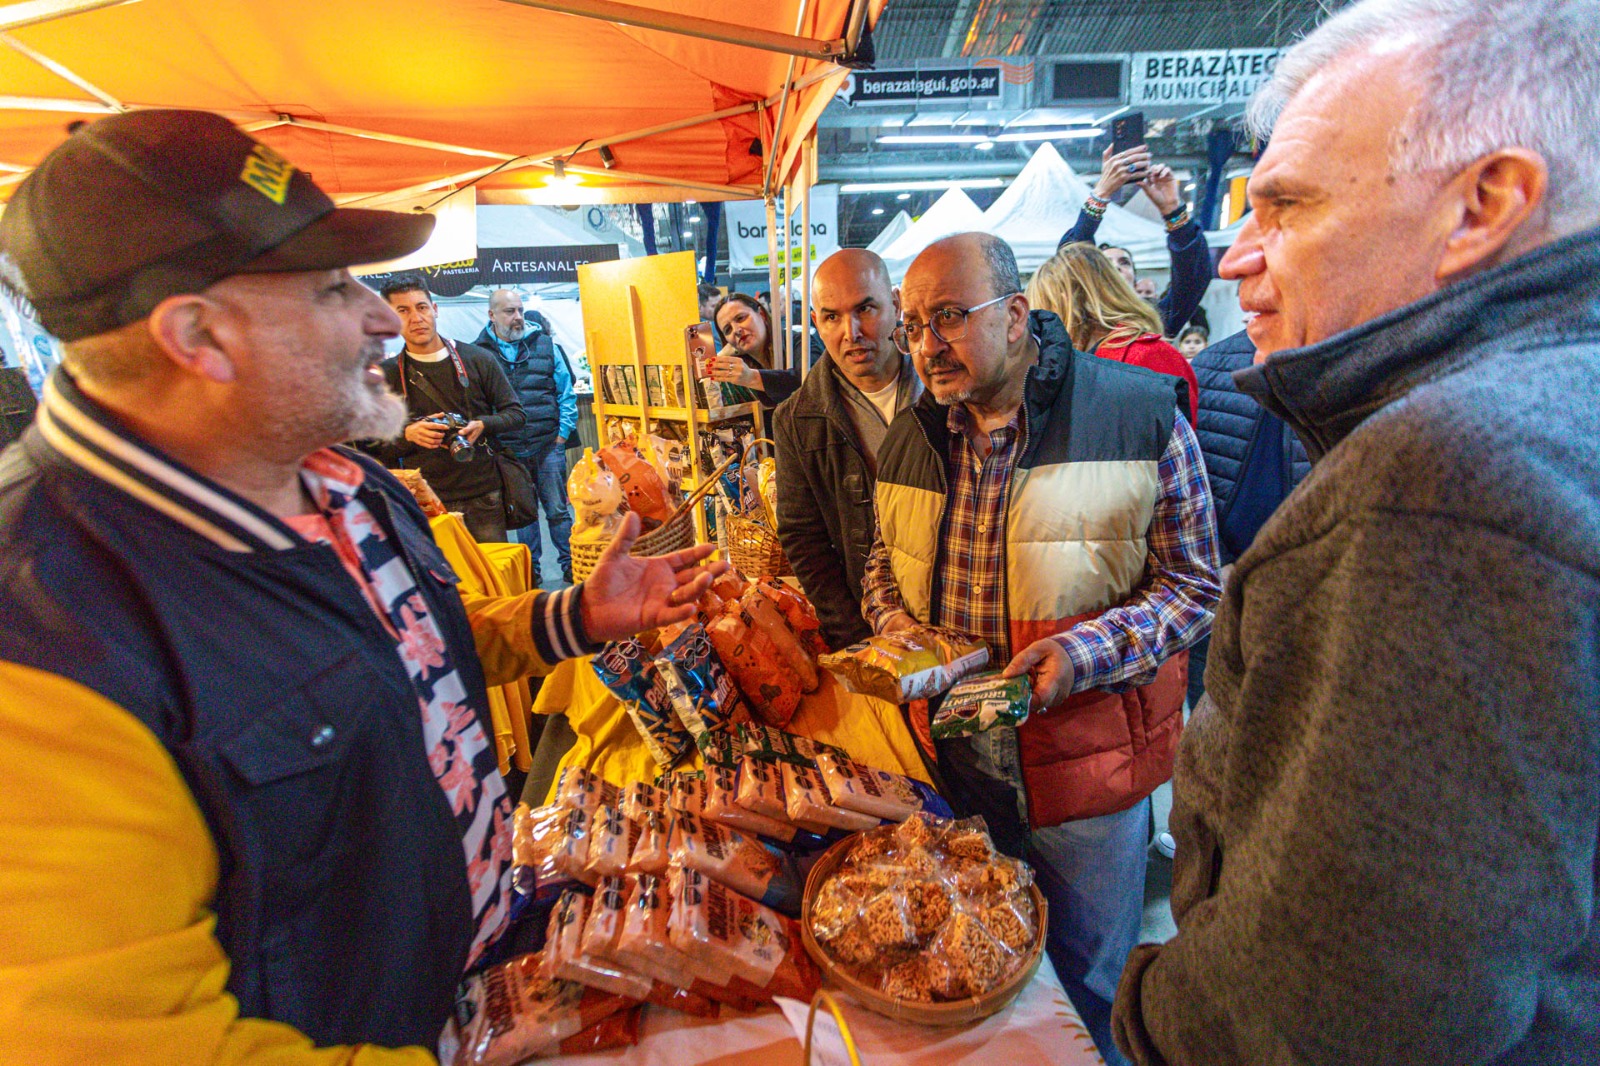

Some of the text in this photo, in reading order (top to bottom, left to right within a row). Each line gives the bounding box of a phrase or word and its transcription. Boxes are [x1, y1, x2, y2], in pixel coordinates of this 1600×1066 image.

[1144, 51, 1286, 79] BERAZATEG
[862, 76, 997, 95] berazategui.gob.ar
[737, 219, 828, 239] barlona
[442, 266, 480, 276] PASTELERIA
